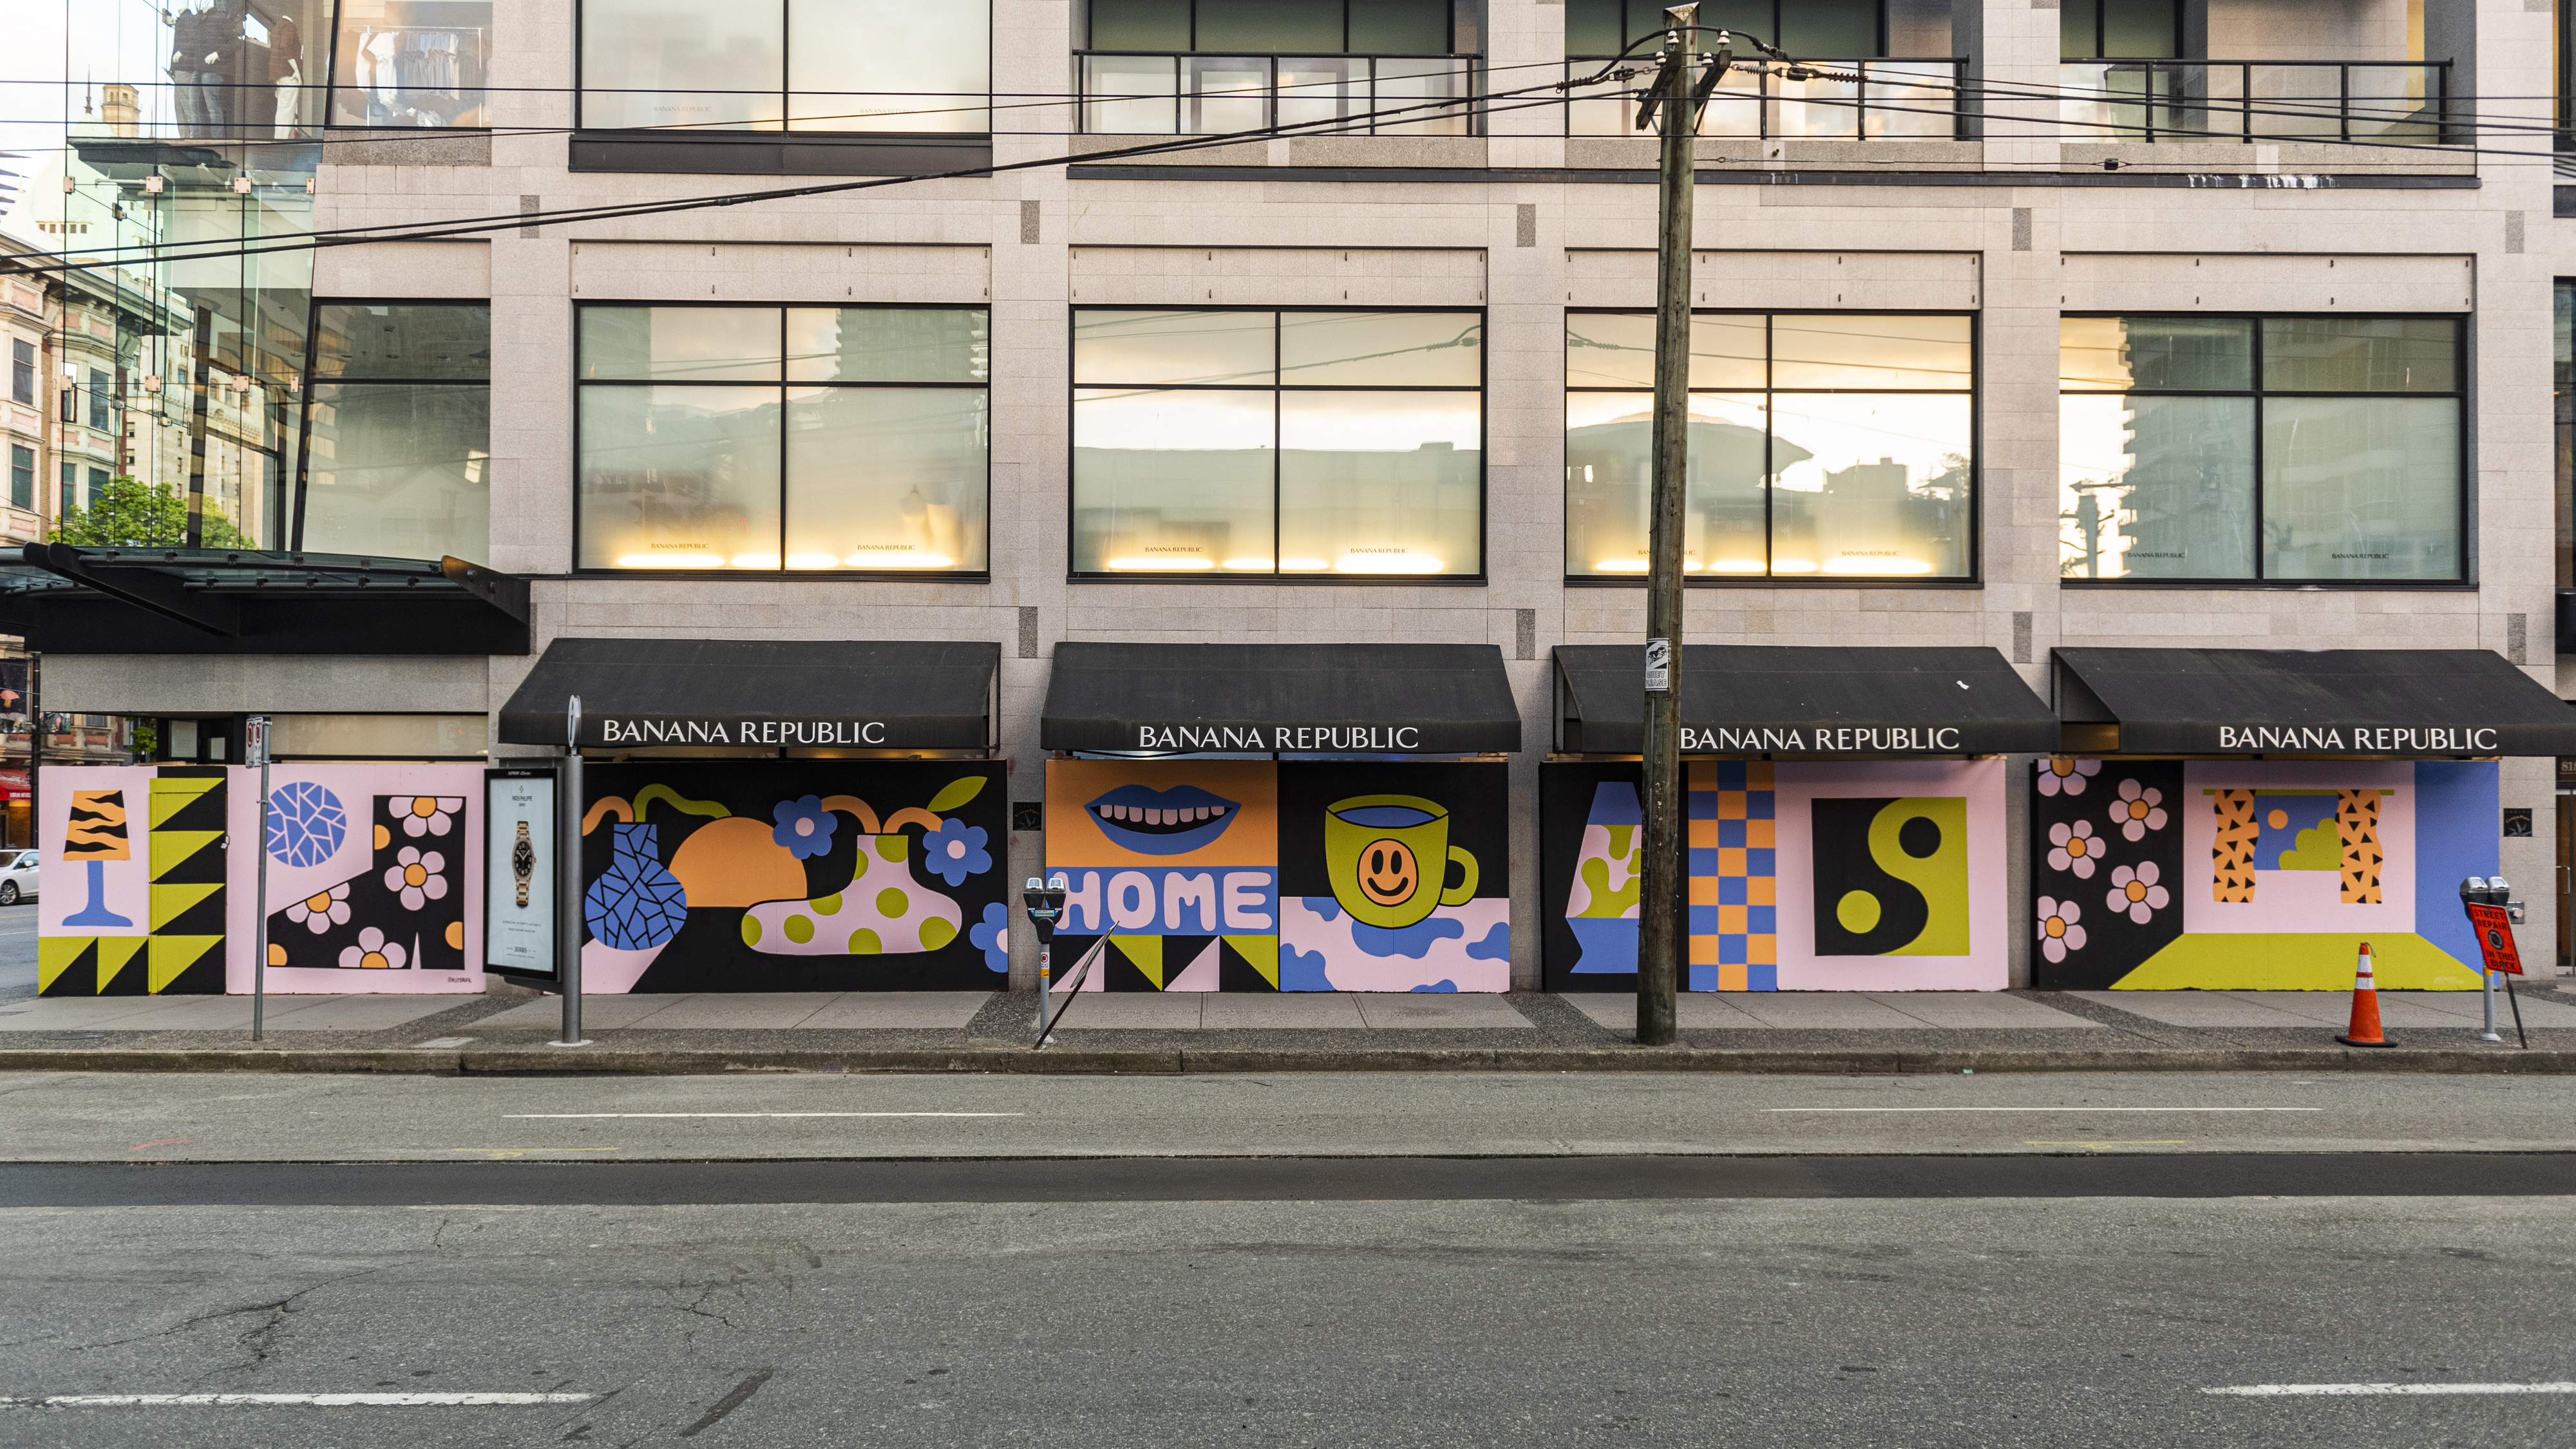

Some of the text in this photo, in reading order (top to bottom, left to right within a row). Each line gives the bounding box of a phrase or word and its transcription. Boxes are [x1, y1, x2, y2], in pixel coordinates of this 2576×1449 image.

[1645, 679, 1667, 687] PLEASE
[603, 719, 885, 744] BANANA REPUBLIC
[1139, 726, 1419, 749] BANANA REPUBLIC
[1680, 727, 1960, 750] BANANA REPUBLIC
[2219, 726, 2497, 750] BANANA REPUBLIC
[1053, 871, 1273, 931] HOME
[2474, 909, 2505, 920] STREET
[2476, 919, 2508, 930] REPAIR
[2486, 950, 2515, 961] IN THIS
